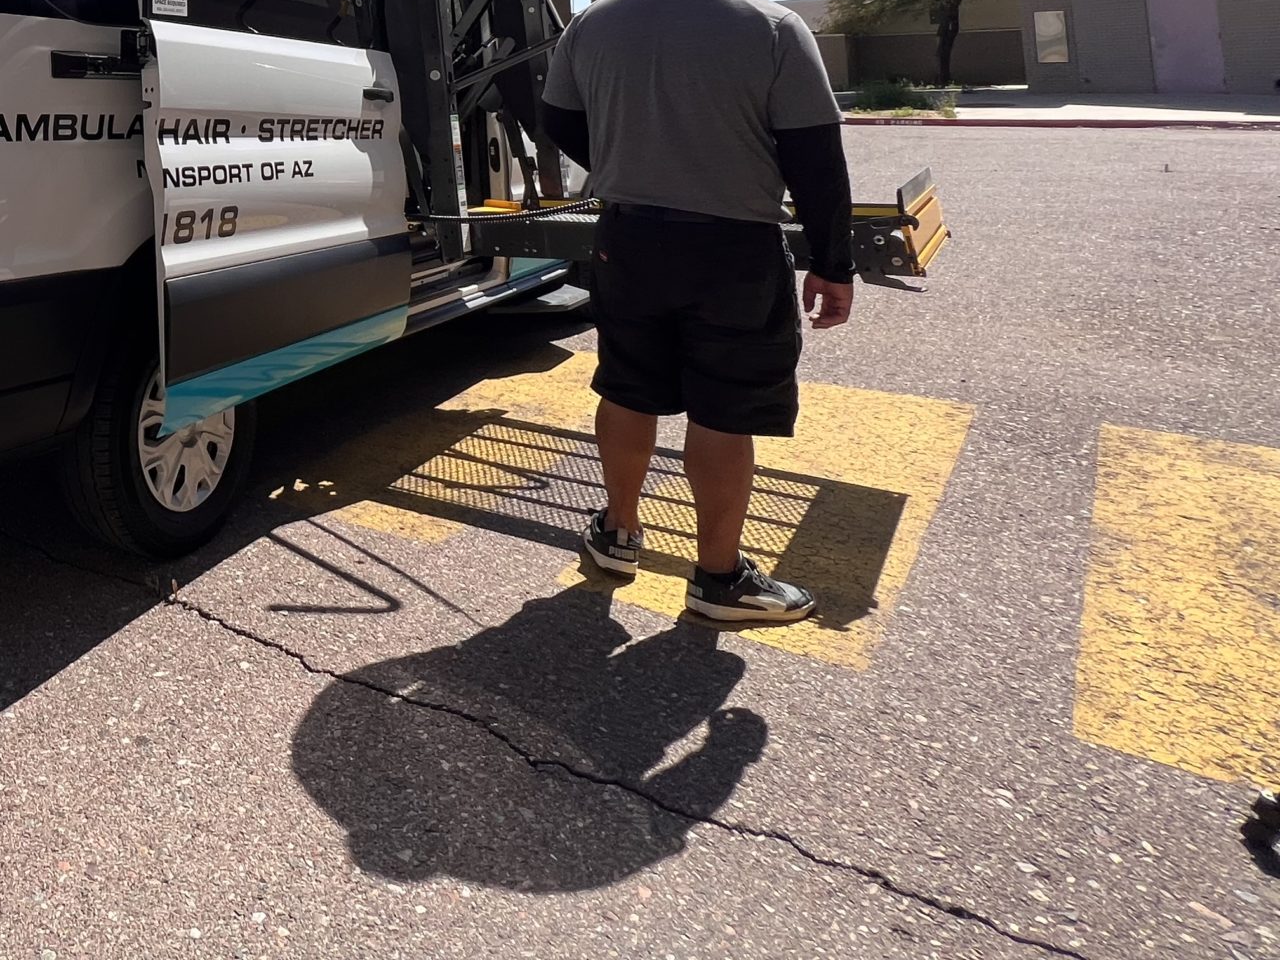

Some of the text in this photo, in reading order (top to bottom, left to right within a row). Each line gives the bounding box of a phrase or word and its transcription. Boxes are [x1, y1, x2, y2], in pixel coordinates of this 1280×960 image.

[156, 118, 385, 146] HAIR STRETCHER
[163, 162, 253, 189] NSPORT
[261, 161, 285, 181] OF
[290, 160, 314, 179] AZ
